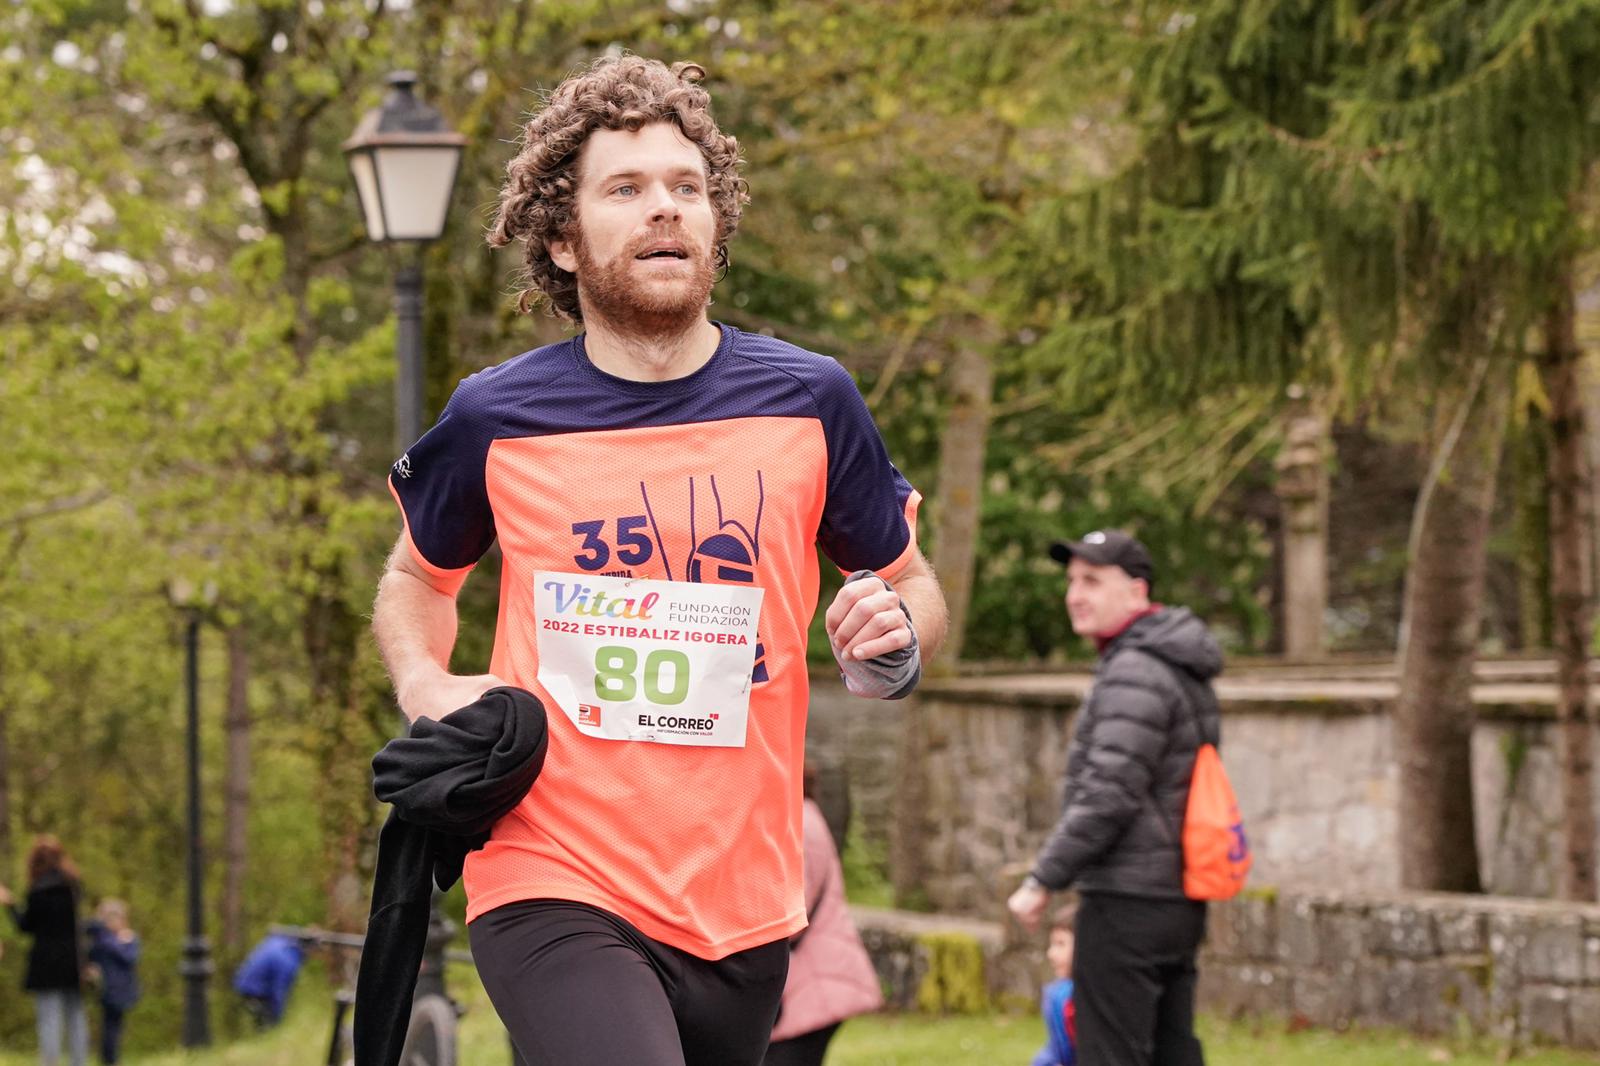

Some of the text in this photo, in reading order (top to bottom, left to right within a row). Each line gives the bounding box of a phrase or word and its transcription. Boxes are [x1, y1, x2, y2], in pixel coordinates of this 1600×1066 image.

[571, 515, 653, 571] 35
[543, 581, 660, 621] Vital
[669, 602, 751, 616] FUNDACIÓN
[543, 619, 748, 646] 2022 ESTIBALIZ IGOERA
[669, 613, 748, 626] FUNDAZIOA
[594, 645, 690, 706] 80
[638, 714, 714, 731] EL CORREO
